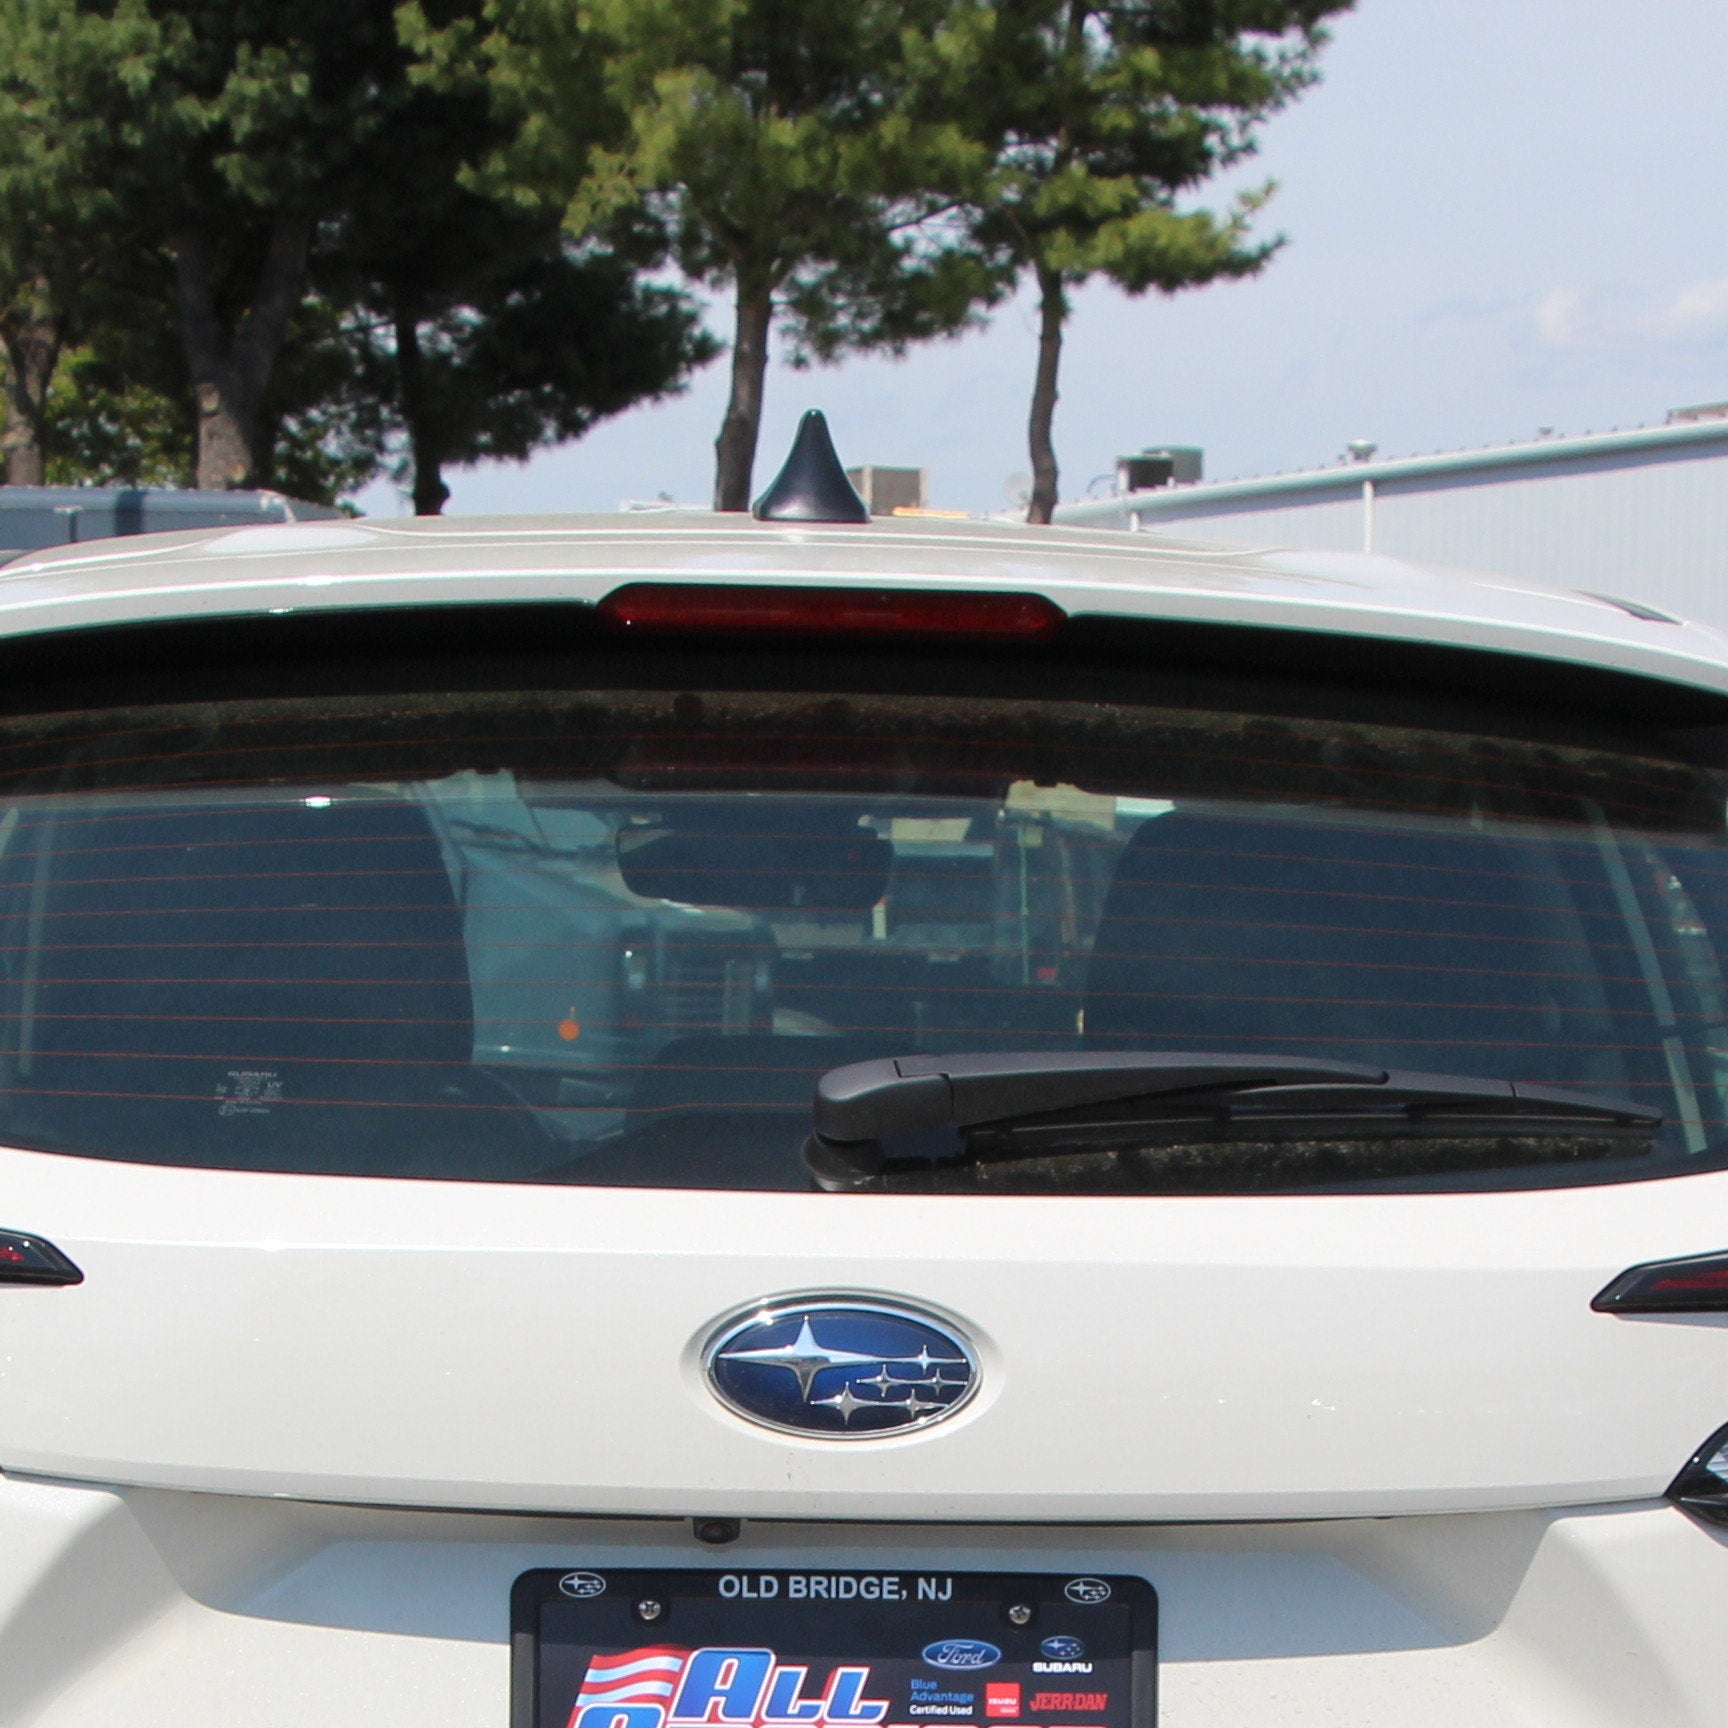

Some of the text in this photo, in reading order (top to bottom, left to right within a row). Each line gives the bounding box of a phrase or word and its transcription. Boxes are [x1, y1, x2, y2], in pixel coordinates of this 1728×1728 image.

[719, 1576, 953, 1601] OLD BRIDGE, NJ
[937, 1643, 986, 1665] Ford
[1032, 1662, 1093, 1673] SUBARU
[667, 1646, 890, 1724] ALL
[911, 1679, 938, 1689] Blue
[910, 1692, 974, 1703] Advantage
[909, 1704, 973, 1715] Certified Used
